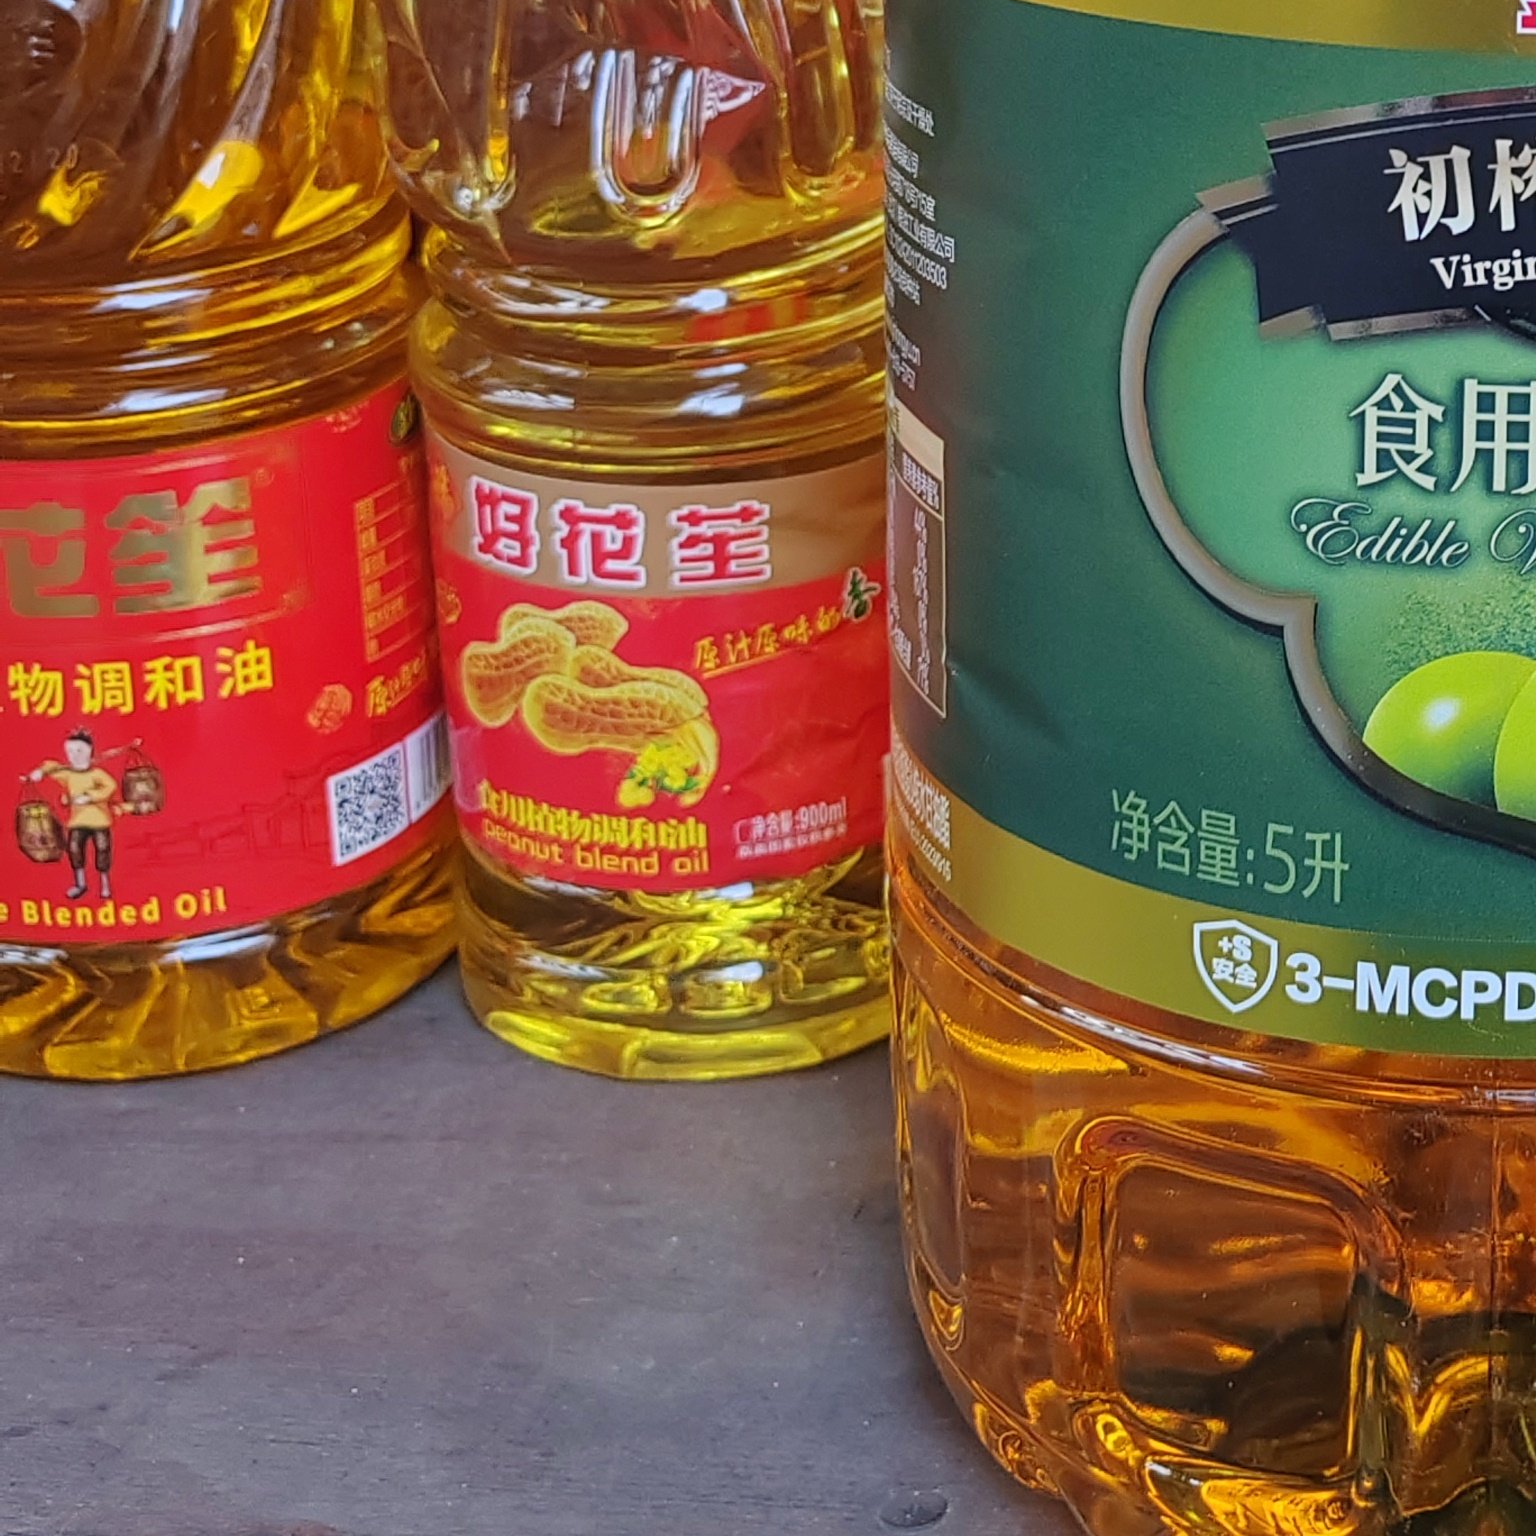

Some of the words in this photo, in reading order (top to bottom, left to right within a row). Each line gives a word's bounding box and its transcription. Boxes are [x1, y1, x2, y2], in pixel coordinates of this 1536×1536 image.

[1291, 497, 1471, 568] Edible
[0, 639, 274, 716] 物调和油
[574, 844, 660, 876] blend
[672, 850, 710, 874] oil
[20, 896, 160, 928] Blended
[175, 886, 227, 919] Oil
